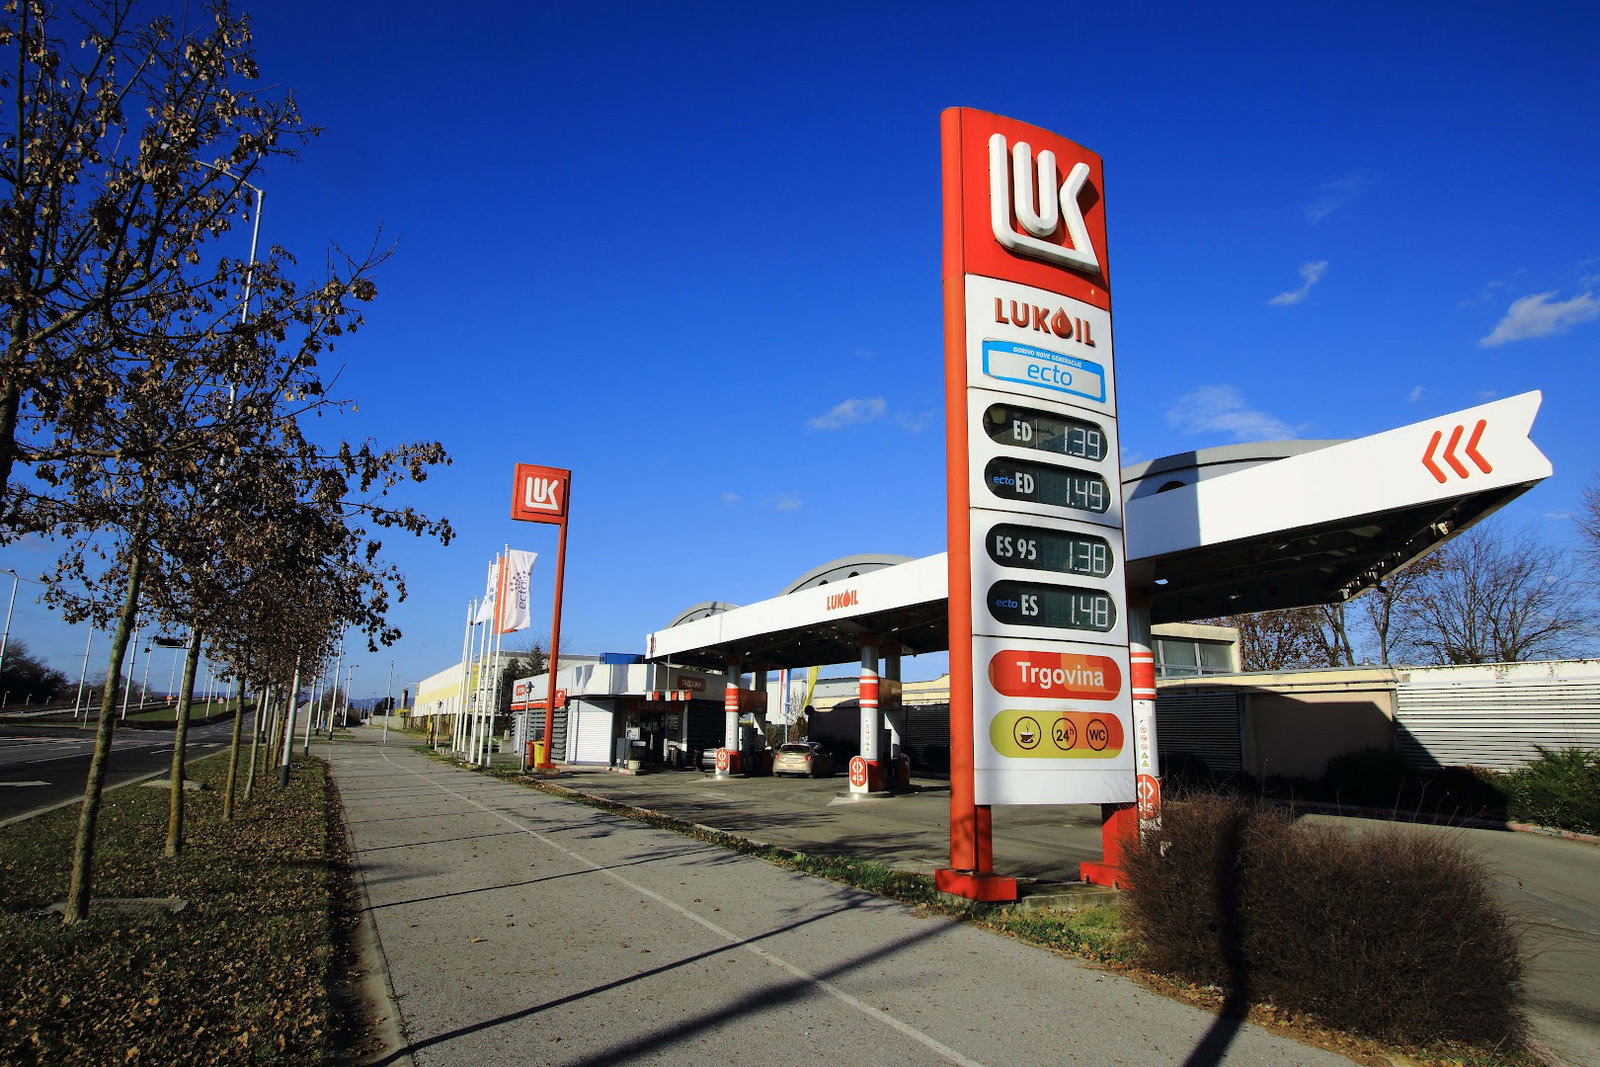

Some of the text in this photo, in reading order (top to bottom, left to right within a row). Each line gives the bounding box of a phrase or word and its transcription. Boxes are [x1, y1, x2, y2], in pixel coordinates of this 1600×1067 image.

[989, 133, 1099, 273] LUK
[994, 296, 1096, 347] LUKOIL
[1012, 346, 1035, 356] GORIVO
[1035, 351, 1051, 360] NOVE
[1027, 363, 1073, 386] ecto
[1013, 419, 1101, 460] ED 1.39
[524, 476, 559, 511] LUK
[992, 472, 1103, 511] ecto ED 1.49
[995, 535, 1107, 574] ES 95 1.38
[518, 581, 528, 610] ecto
[826, 588, 859, 612] LUKOIL
[995, 594, 1109, 627] ecto ES 1.48
[1016, 661, 1105, 690] Trgovina
[1089, 729, 1106, 742] WC
